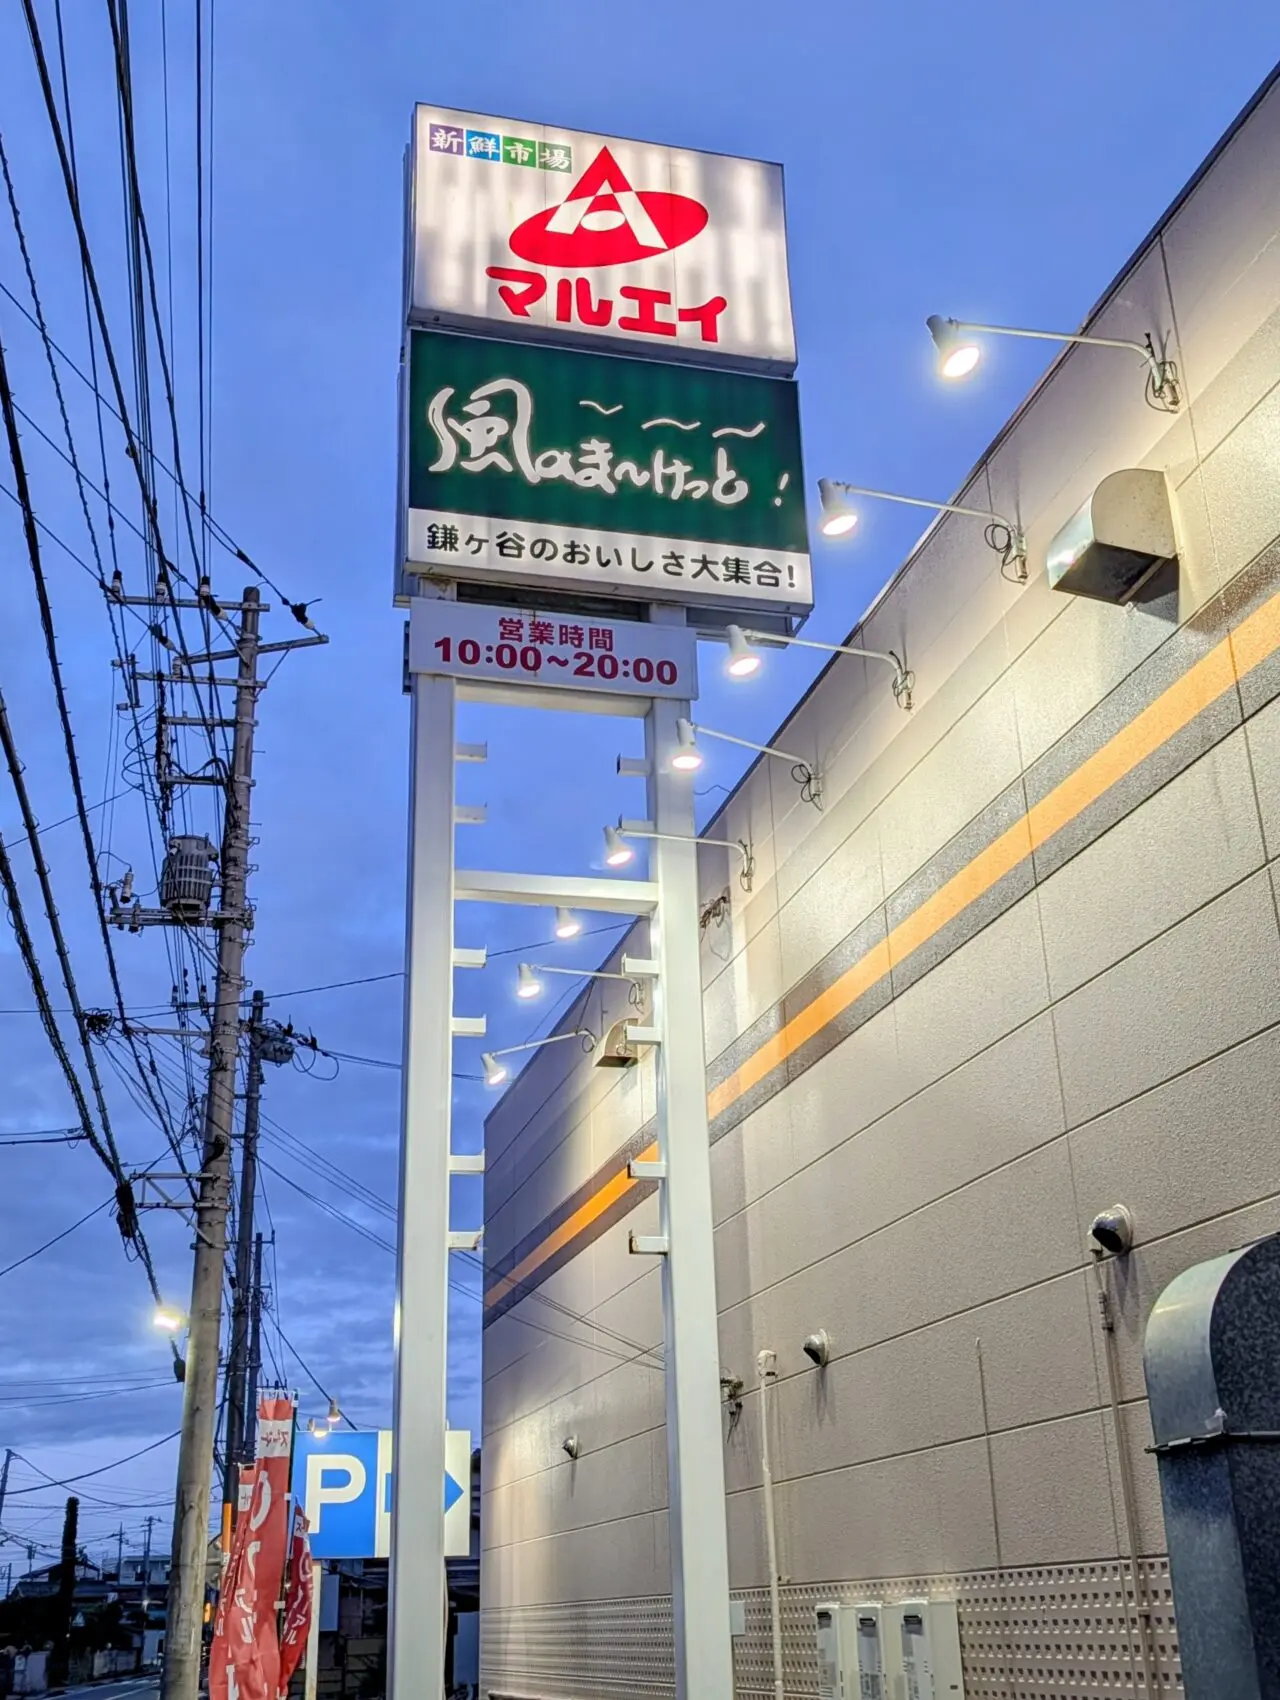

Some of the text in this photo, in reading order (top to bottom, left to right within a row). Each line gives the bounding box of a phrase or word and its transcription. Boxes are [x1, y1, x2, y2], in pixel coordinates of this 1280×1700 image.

[430, 127, 572, 172] 新鮮市場
[485, 266, 727, 343] マルエイ
[498, 617, 614, 652] 営業時間
[306, 1454, 365, 1533] P
